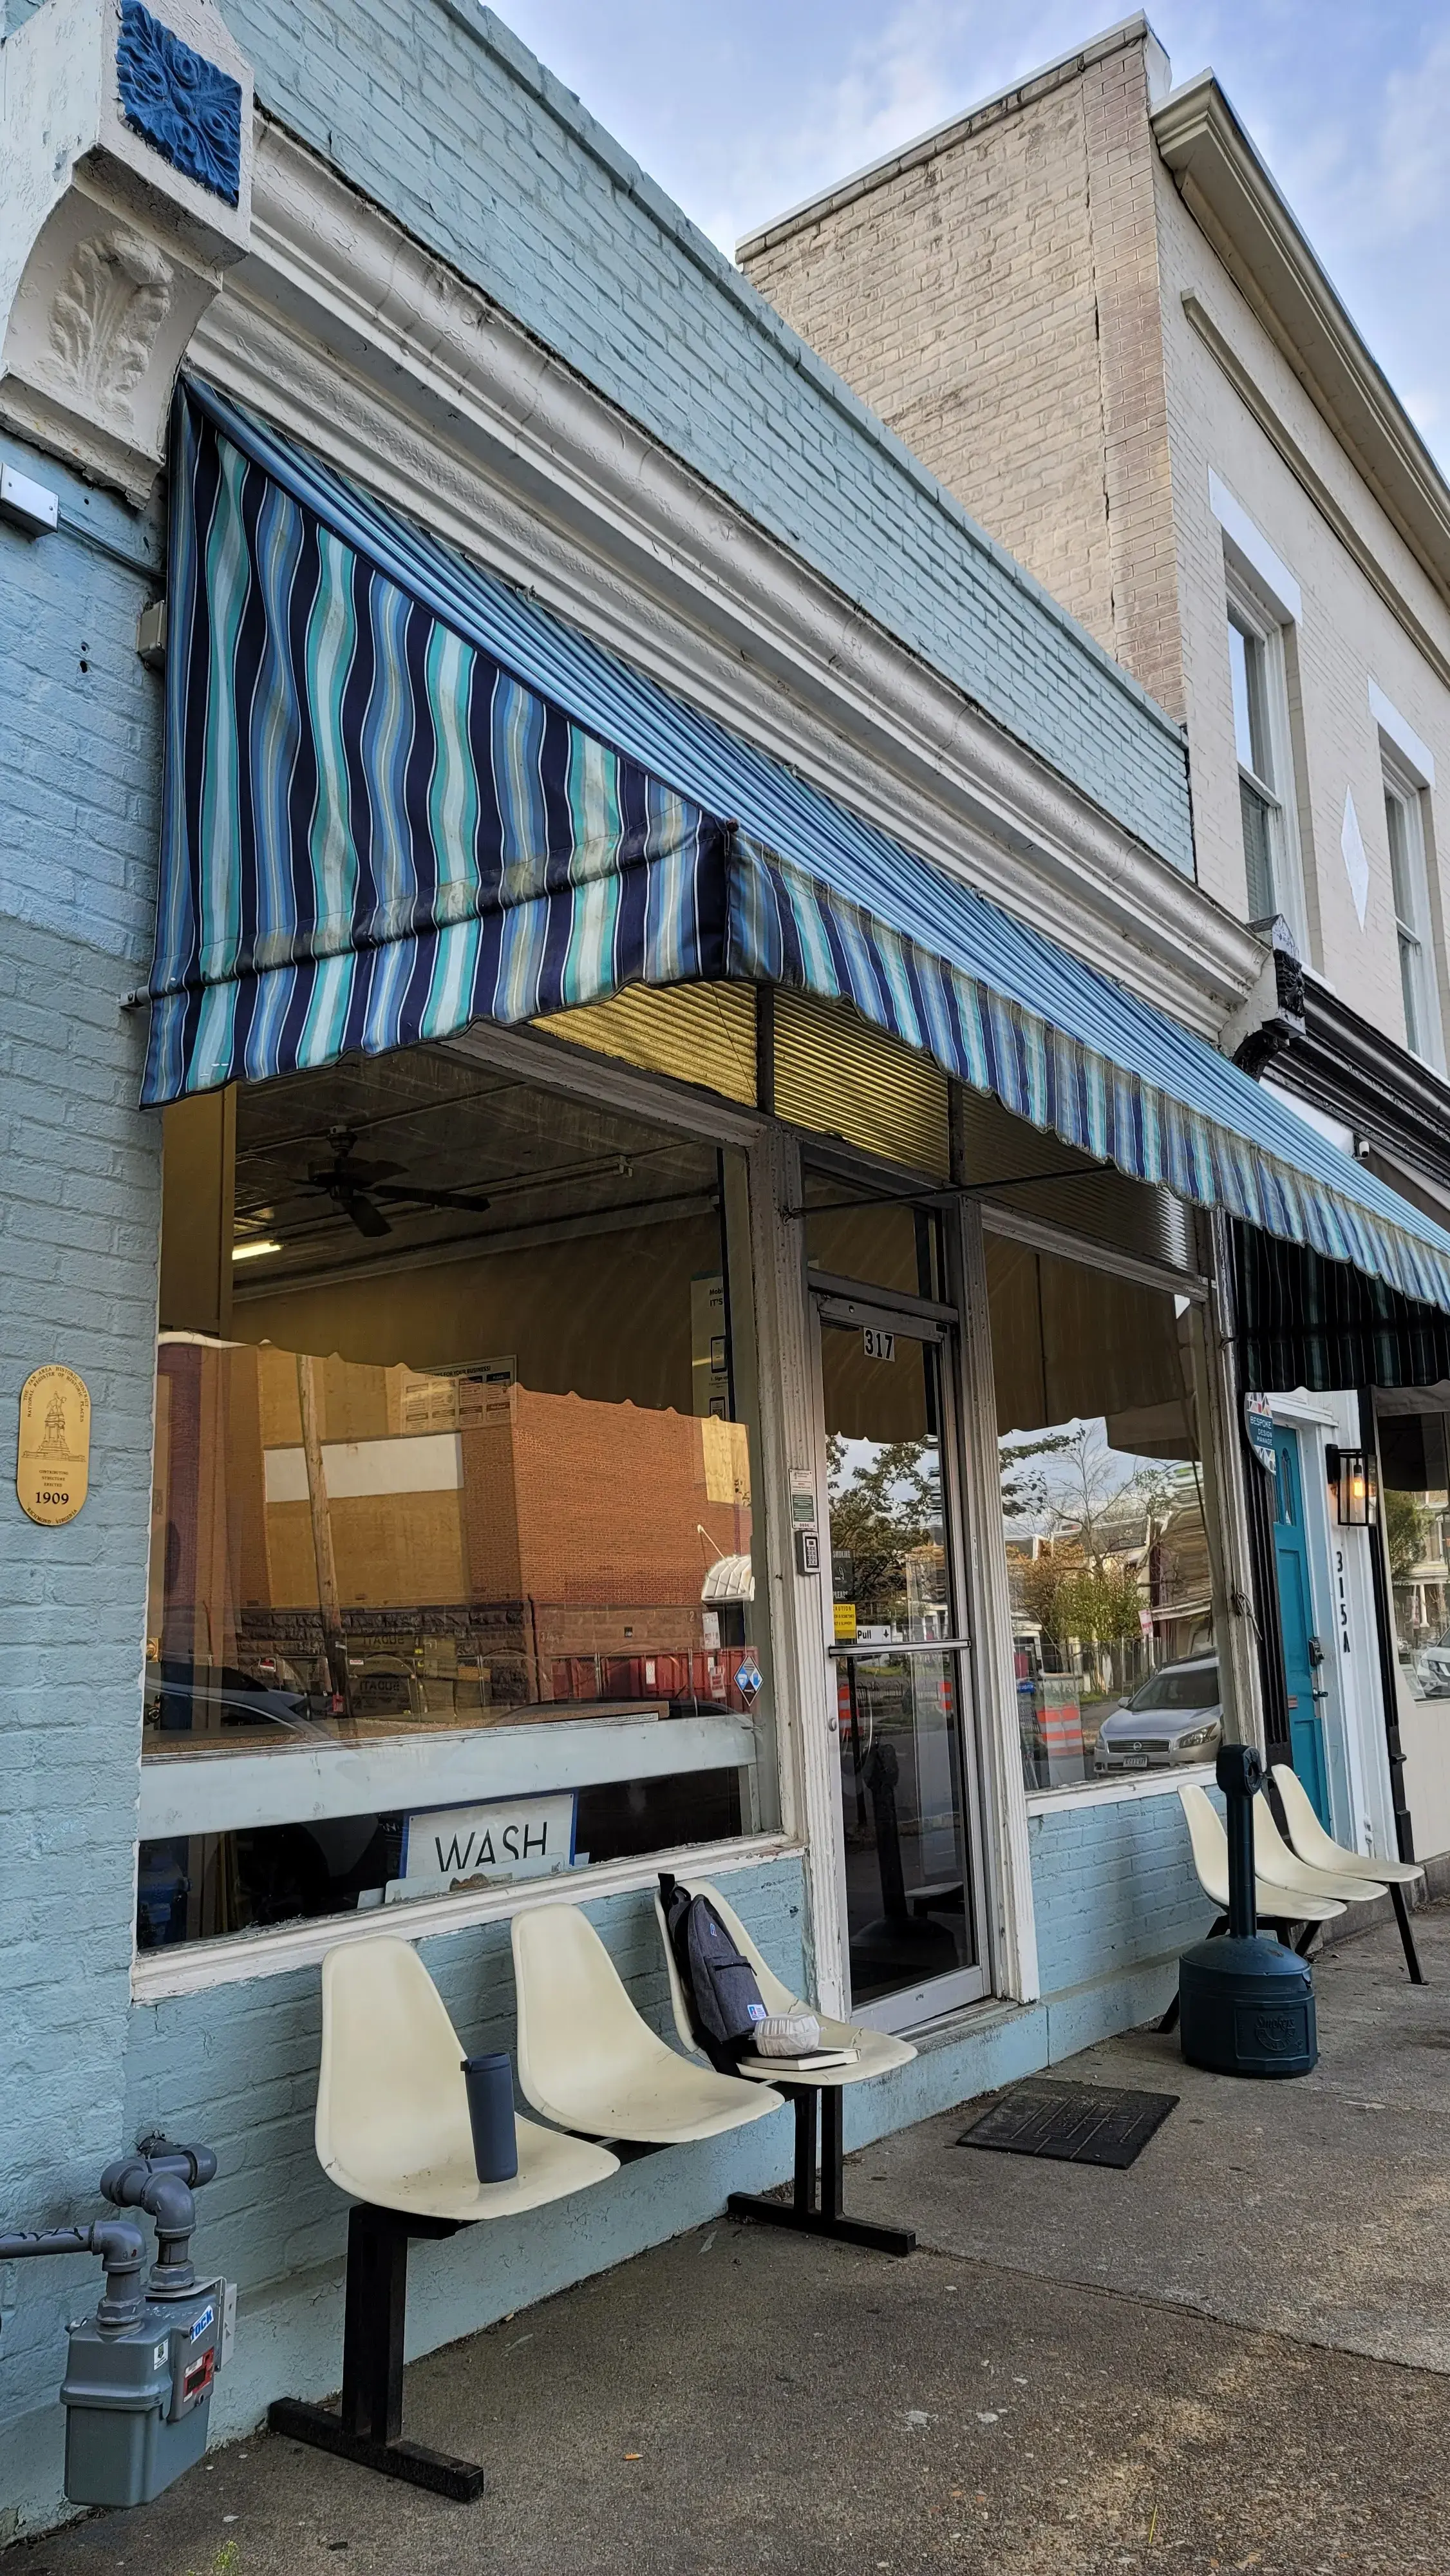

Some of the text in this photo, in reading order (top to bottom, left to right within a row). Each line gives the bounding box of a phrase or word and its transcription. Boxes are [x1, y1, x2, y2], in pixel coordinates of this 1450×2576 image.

[710, 1298, 723, 1307] IT'S
[865, 1329, 893, 1359] 317
[467, 1365, 491, 1374] BUSINESS!
[28, 1376, 37, 1386] FAN
[39, 1367, 52, 1376] AREA
[55, 1366, 79, 1381] HISTORIC
[79, 1381, 89, 1408] DISTRICT
[33, 1372, 55, 1388] REGISTER
[66, 1376, 82, 1398] HISTORIC
[1250, 1416, 1272, 1430] BESPOKE
[1257, 1428, 1273, 1438] DESIGN
[1256, 1435, 1273, 1446] MANAGE
[35, 1492, 69, 1505] 1909
[26, 1507, 78, 1524] RICHMOND VIRGINIA
[1336, 1551, 1350, 1653] 315A
[857, 1630, 872, 1640] Pull
[435, 1821, 547, 1872] WASH
